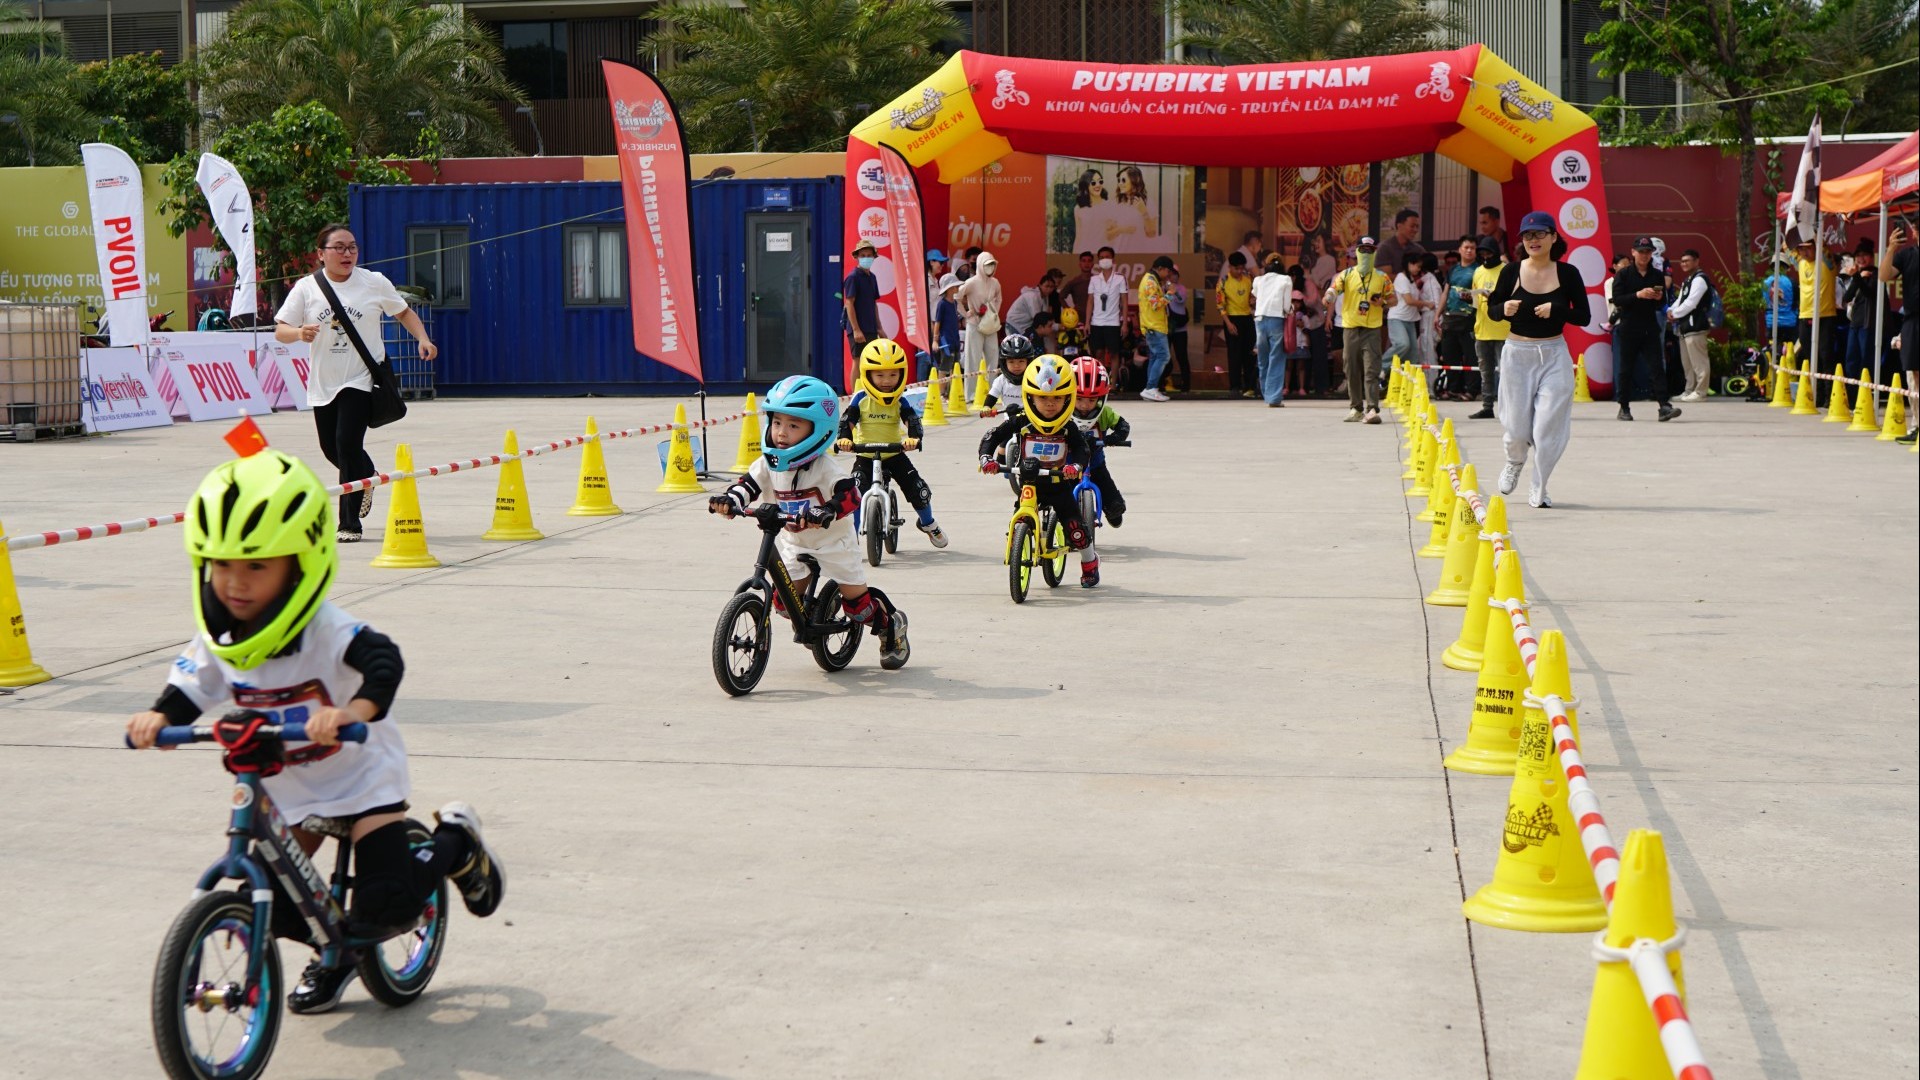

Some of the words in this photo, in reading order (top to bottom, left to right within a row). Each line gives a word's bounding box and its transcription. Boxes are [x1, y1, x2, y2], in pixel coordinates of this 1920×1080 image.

[1072, 70, 1227, 93] PUSHBIKE
[1238, 66, 1371, 92] VIETNAM
[907, 111, 965, 152] PUSHBIKE.VN
[1474, 104, 1537, 145] PUSHBIKE.VN
[962, 176, 977, 184] THE
[1014, 176, 1033, 184] CITY
[16, 226, 39, 237] THE
[44, 226, 95, 237] GLOBAL
[948, 215, 1012, 248] ỜNG
[104, 216, 141, 300] PVOIL
[23, 273, 73, 291] TƯỢNG
[186, 362, 251, 404] PVOIL
[1032, 442, 1060, 455] 221
